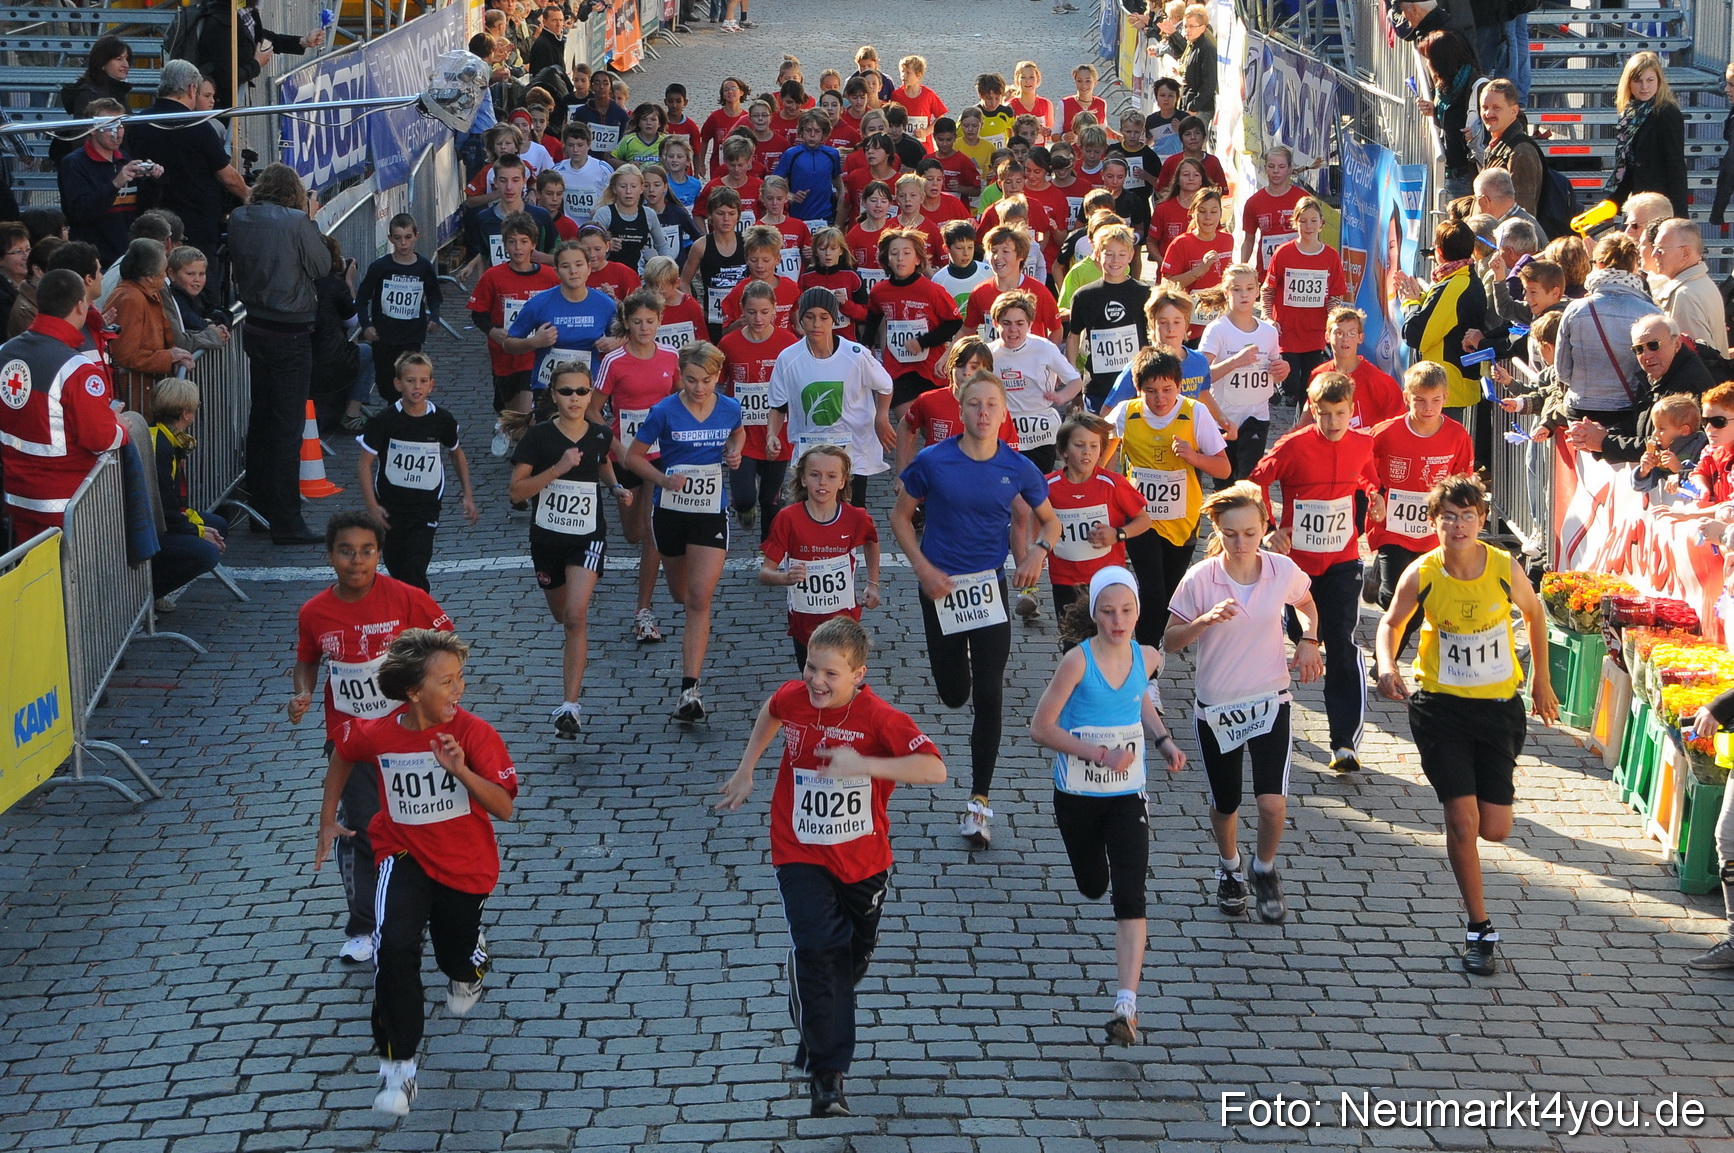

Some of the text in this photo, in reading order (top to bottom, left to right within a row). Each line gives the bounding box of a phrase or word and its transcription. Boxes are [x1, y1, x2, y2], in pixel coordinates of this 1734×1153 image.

[565, 194, 594, 207] 4049
[775, 256, 799, 273] 101
[1288, 279, 1322, 293] 4033
[386, 291, 419, 306] 4087
[1287, 294, 1321, 303] Annalena
[390, 305, 415, 316] Philipp
[1096, 338, 1133, 357] 4015
[1104, 357, 1129, 367] Johan
[1230, 371, 1269, 389] 4109
[741, 394, 770, 410] 408
[681, 429, 730, 440] SPORTWEISS
[1018, 431, 1052, 445] hristoph
[393, 452, 436, 472] 4047
[404, 472, 421, 482] Jan
[682, 476, 716, 495] 035
[1137, 482, 1180, 502] 4029
[545, 492, 591, 516] 4023
[672, 493, 711, 507] Theresa
[1145, 504, 1169, 514] Luca
[1393, 503, 1428, 522] 408
[547, 512, 585, 528] Susann
[1300, 512, 1346, 534] 4072
[1404, 522, 1428, 534] Luca
[1305, 533, 1342, 546] Florian
[796, 571, 846, 594] 4063
[806, 594, 840, 607] Ulrich
[943, 582, 994, 611] 4069
[954, 608, 990, 624] Niklas
[362, 620, 400, 631] NEUMARKTER
[363, 626, 394, 635] STADTLAUF
[1447, 639, 1499, 667] 4111
[339, 677, 377, 700] 401
[352, 699, 387, 714] Steve
[1226, 719, 1266, 742] Vanessa
[787, 741, 798, 750] EU
[803, 774, 834, 785] PFLEIDERER
[1084, 768, 1129, 783] Nadine
[391, 771, 457, 798] 4014
[398, 798, 454, 816] Ricardo
[801, 789, 862, 818] 4026
[797, 818, 866, 835] Alexander
